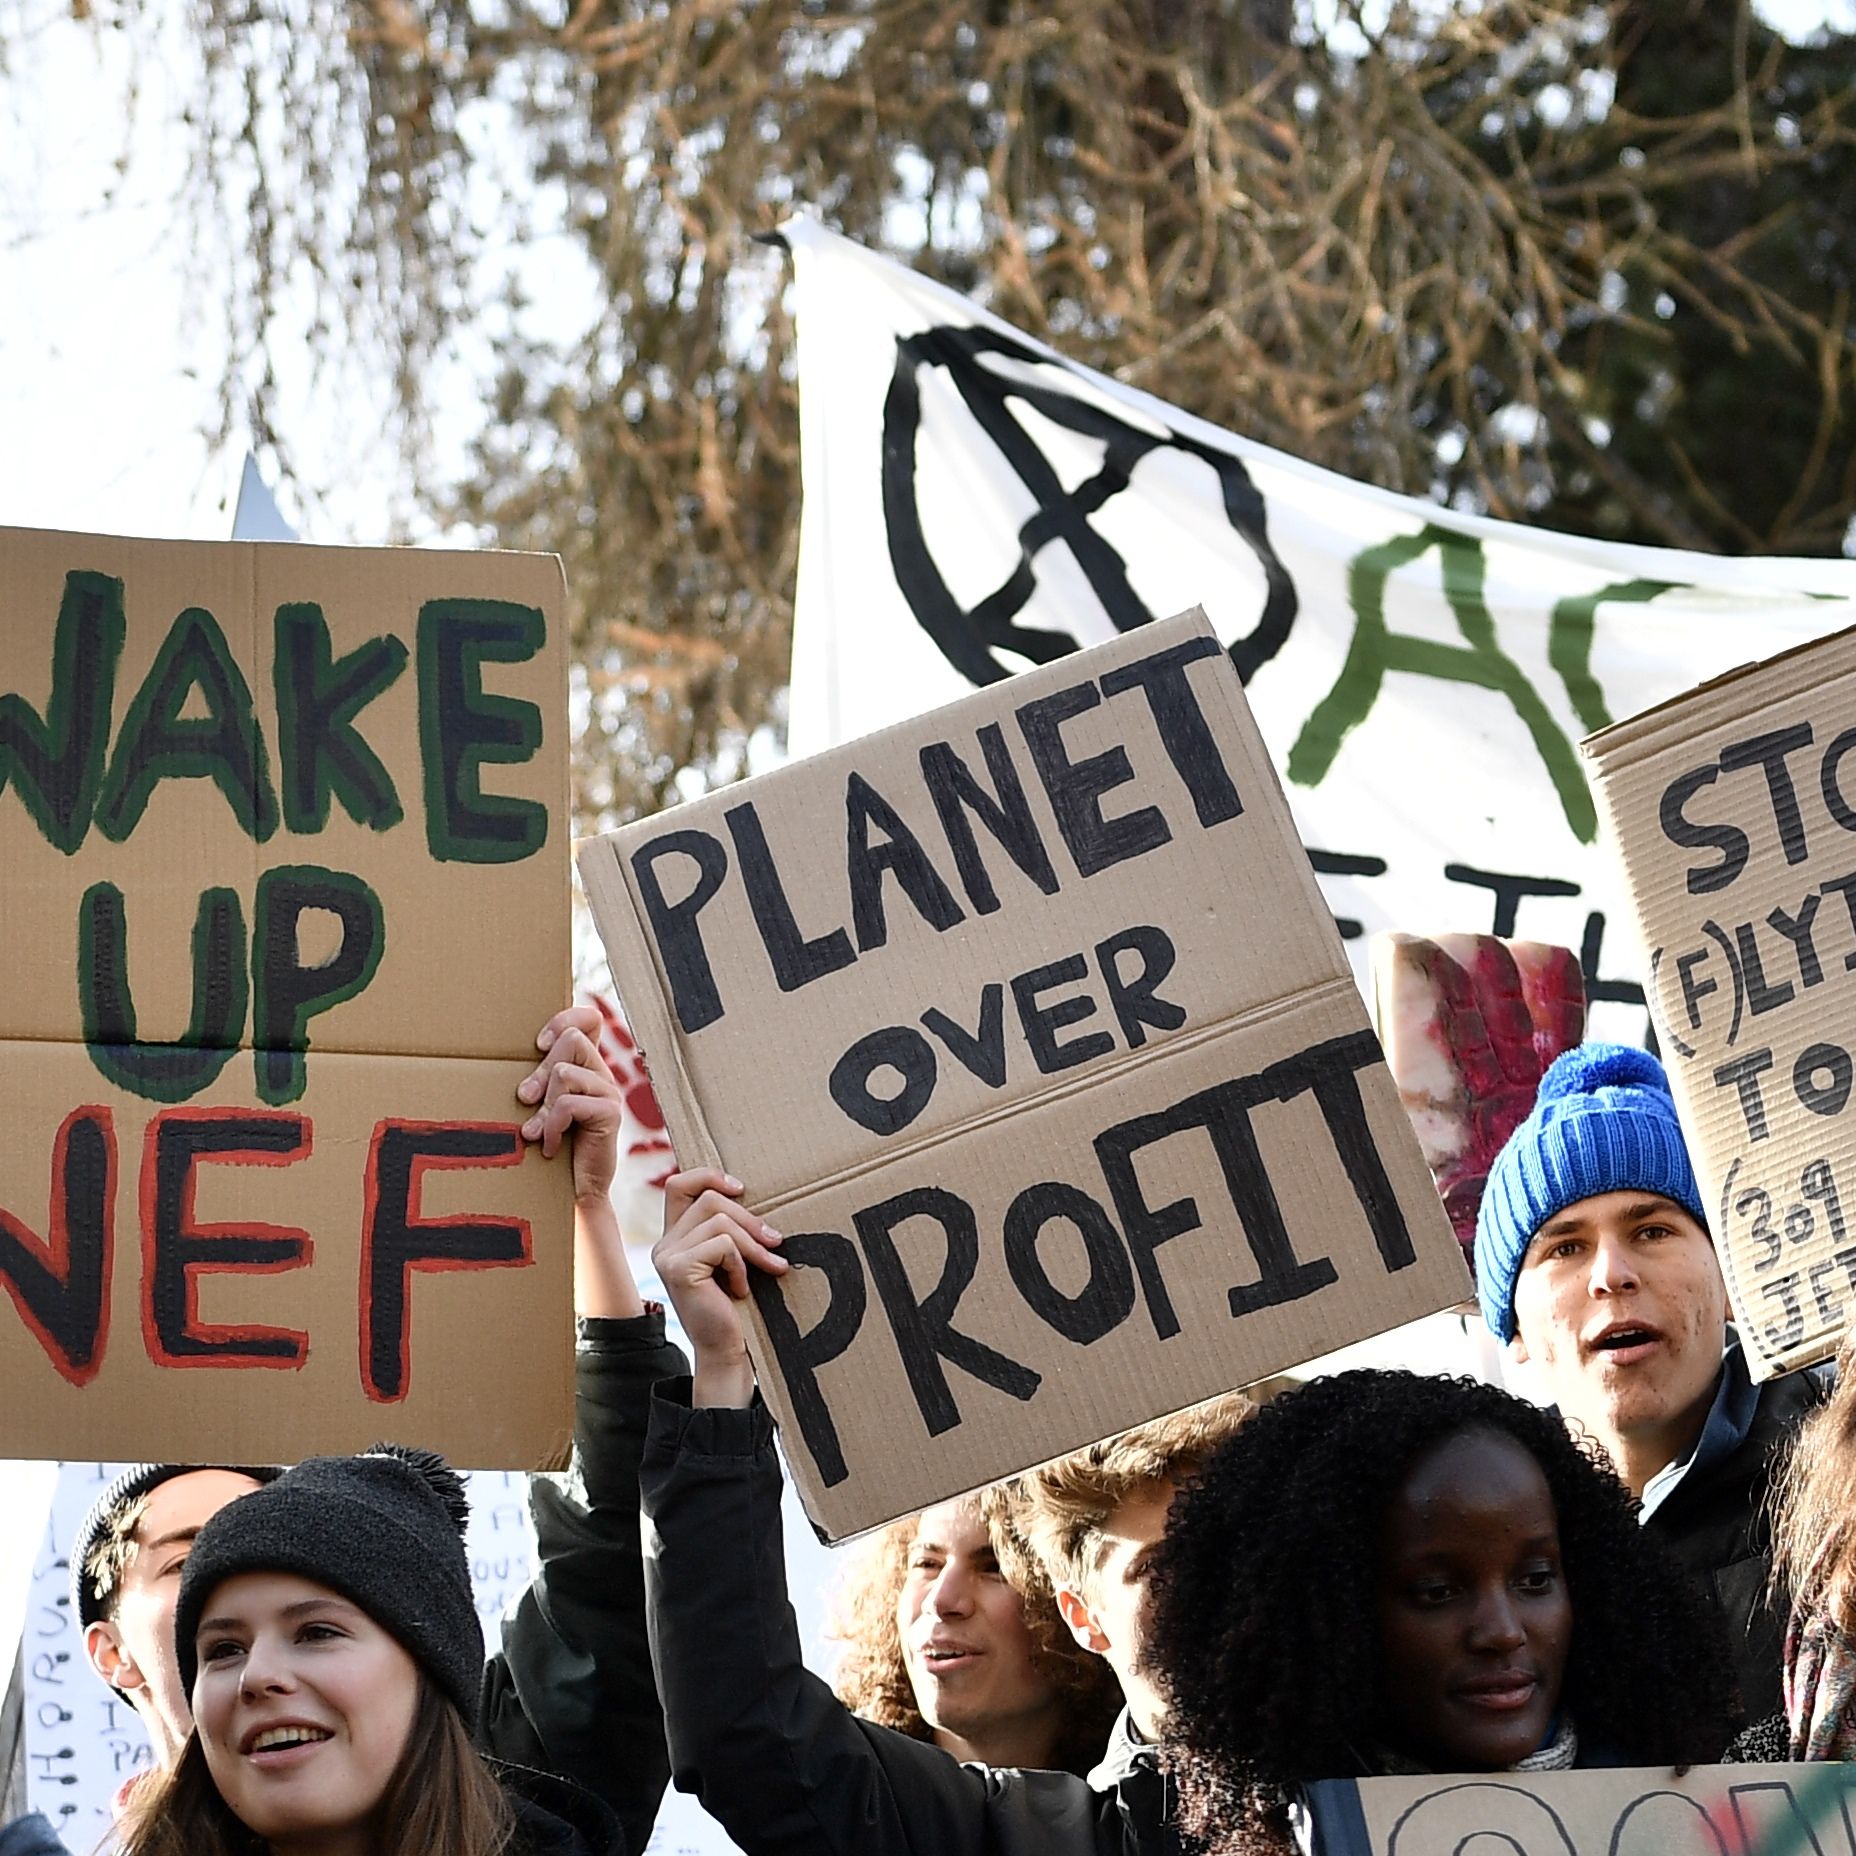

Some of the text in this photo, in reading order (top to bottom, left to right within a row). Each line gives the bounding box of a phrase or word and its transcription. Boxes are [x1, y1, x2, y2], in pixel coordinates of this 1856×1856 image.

[629, 635, 1245, 1035] PLANET
[77, 863, 386, 1107] UP
[827, 924, 1188, 1137] OVER
[1714, 1041, 1854, 1142] TO
[746, 1028, 1417, 1488] PROFIT
